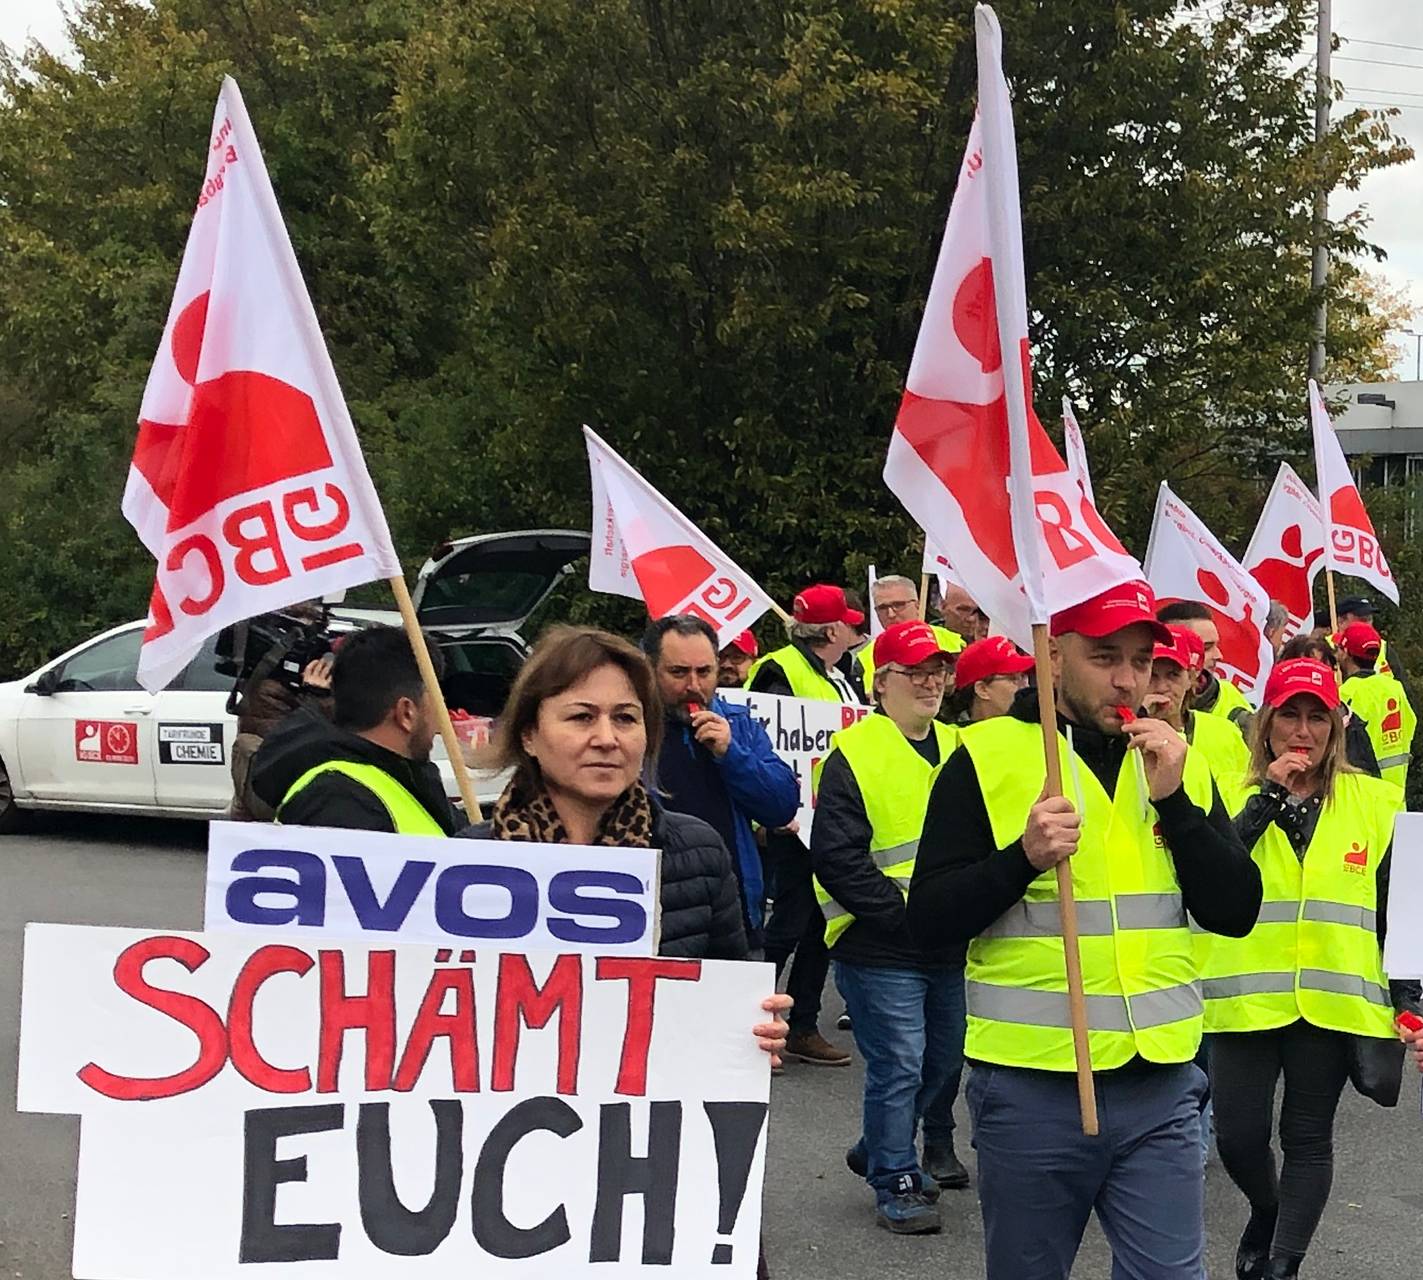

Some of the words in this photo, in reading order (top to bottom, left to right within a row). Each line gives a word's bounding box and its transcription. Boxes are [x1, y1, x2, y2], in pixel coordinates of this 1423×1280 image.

[175, 745, 217, 760] CHEMIE
[225, 848, 646, 944] avos
[77, 936, 703, 1101] SCHÄMT
[239, 1096, 769, 1265] EUCH!
